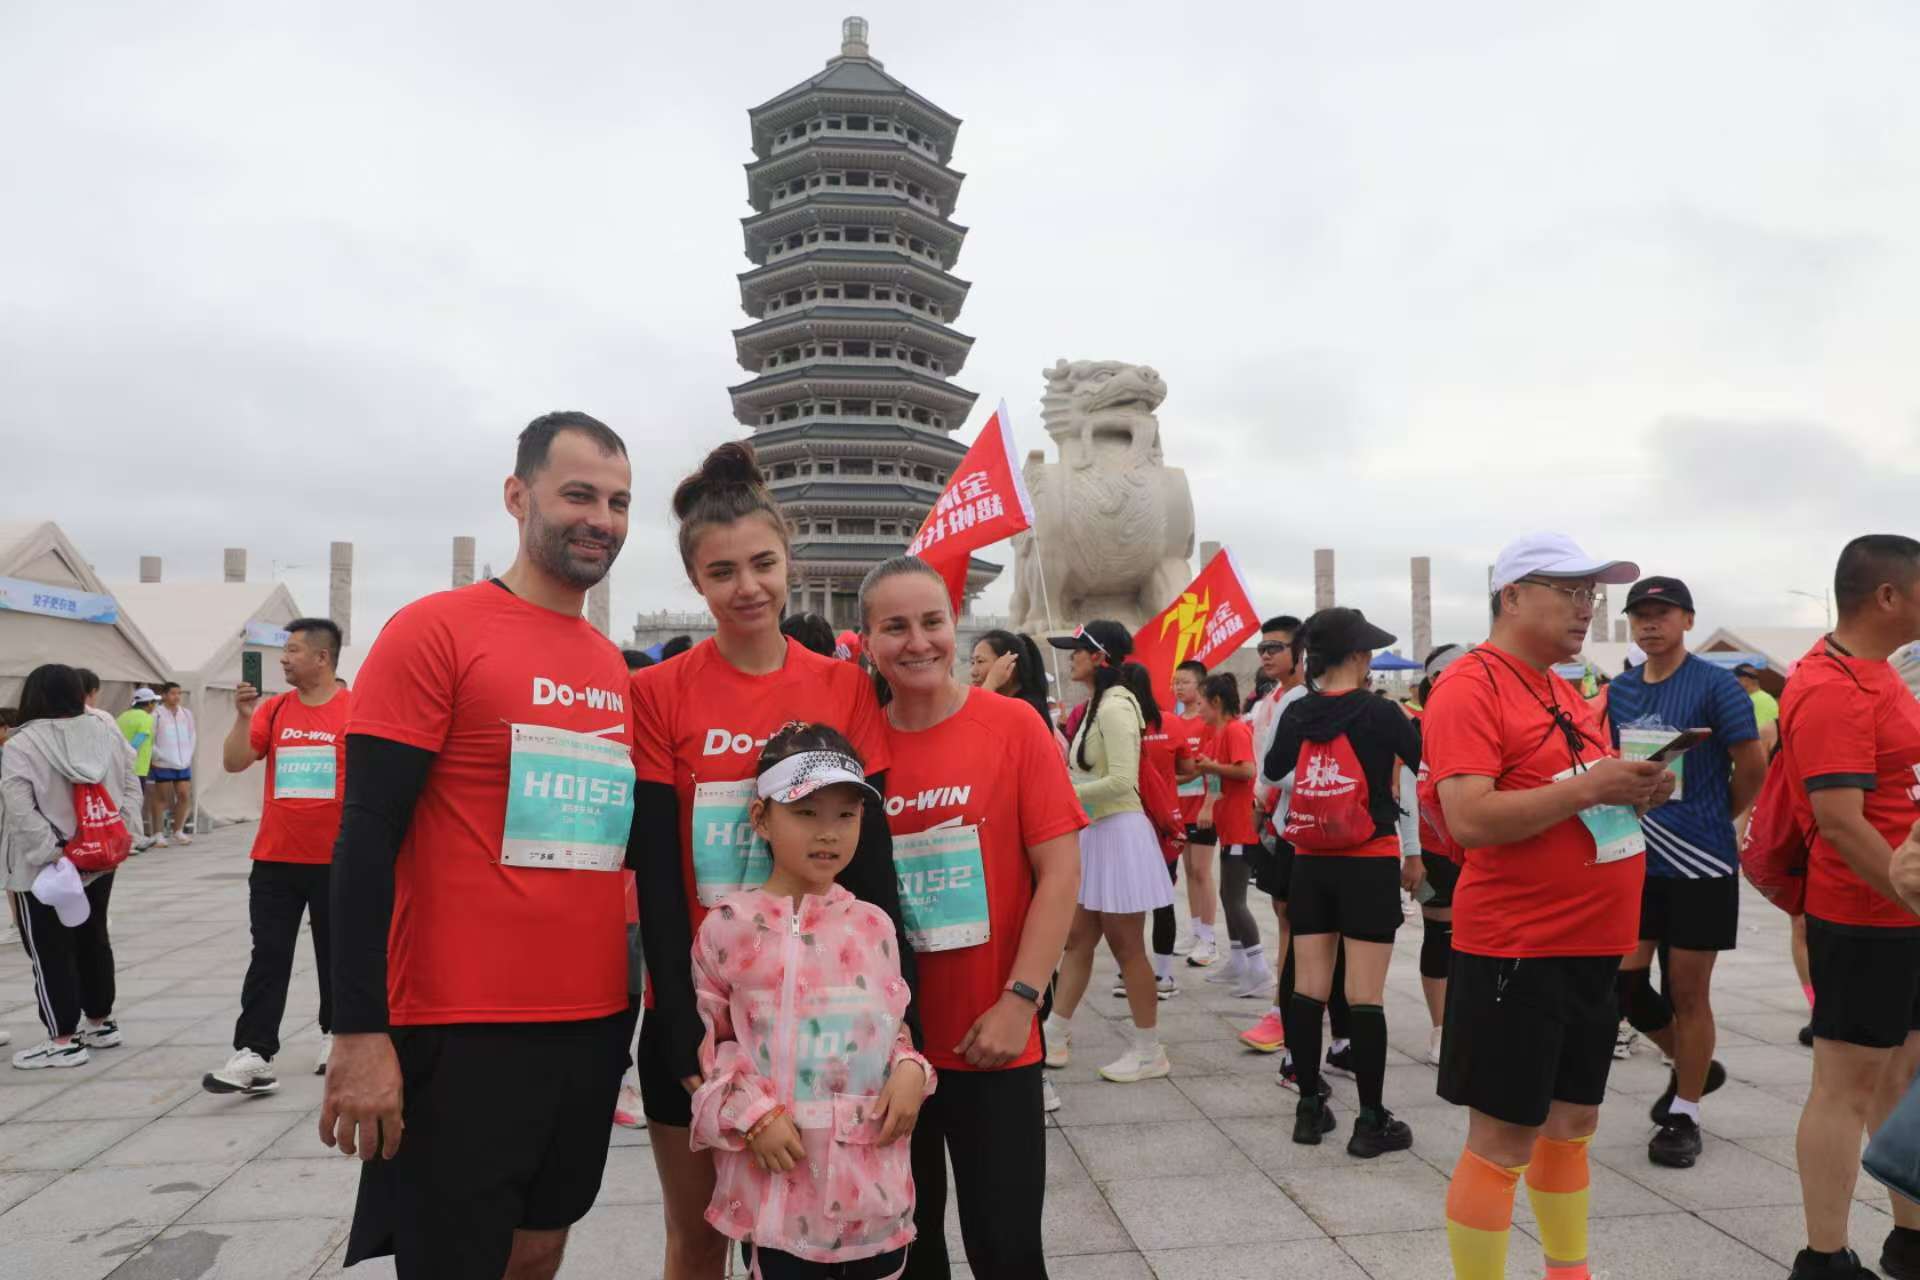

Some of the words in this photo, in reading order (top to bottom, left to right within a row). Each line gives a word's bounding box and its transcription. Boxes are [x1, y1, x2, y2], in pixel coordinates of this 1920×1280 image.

[523, 771, 628, 806] H0153
[882, 785, 971, 816] O-WIN
[898, 865, 973, 895] 0152
